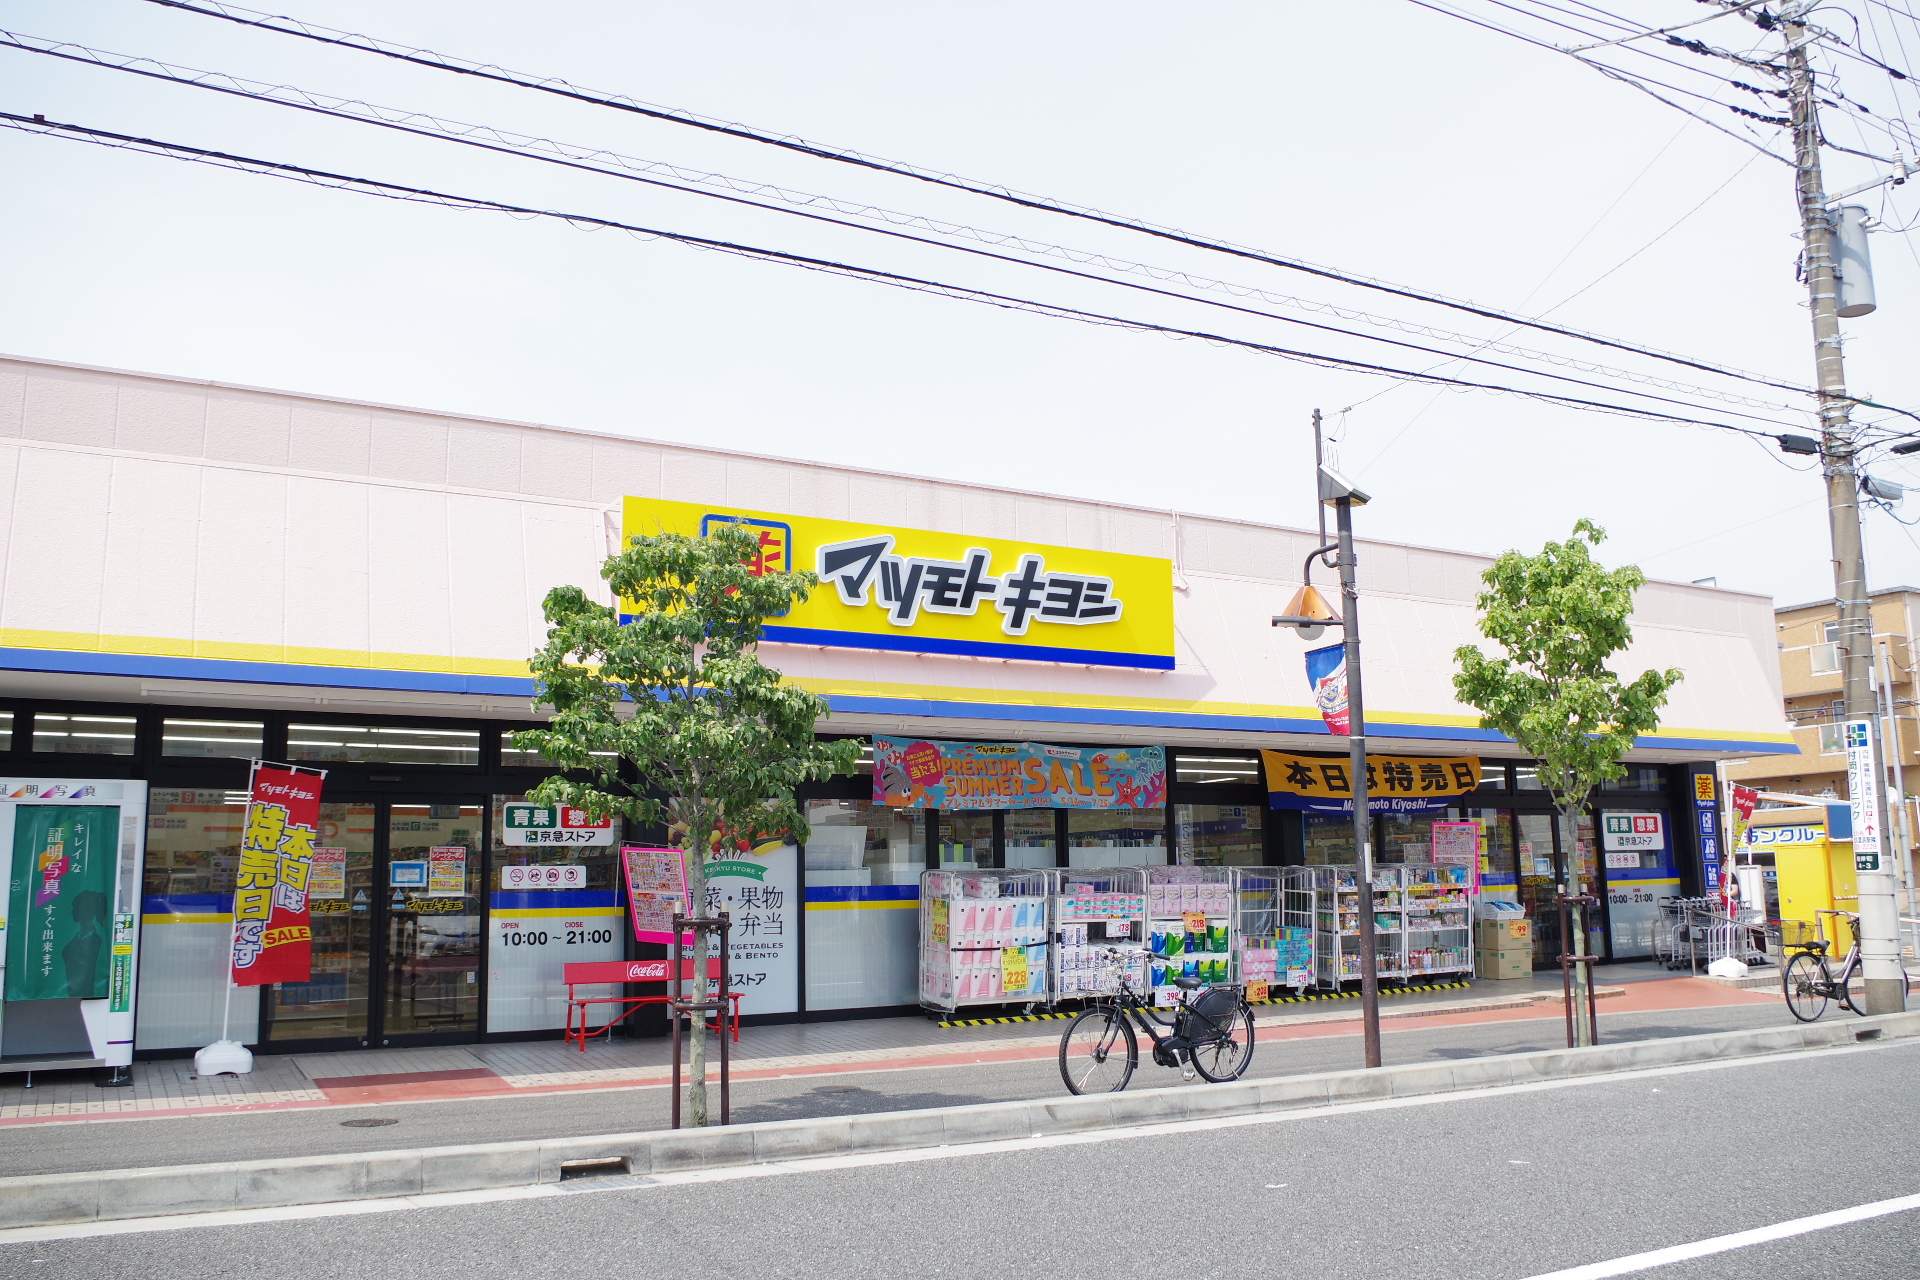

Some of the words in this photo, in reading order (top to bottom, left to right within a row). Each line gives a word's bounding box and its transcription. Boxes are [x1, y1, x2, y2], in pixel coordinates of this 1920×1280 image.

[824, 541, 1118, 629] マツモトキヨシ
[942, 758, 1022, 777] PREMIUM
[943, 775, 1024, 797] SUMMER
[1024, 757, 1114, 797] SALE
[259, 783, 316, 800] マツモトキヨシ
[1343, 800, 1389, 811] Mamoto
[1392, 799, 1427, 811] Kiyoshi
[513, 809, 550, 826] 青果
[539, 831, 596, 843] 京急ストア
[71, 823, 85, 873] キレイな
[43, 827, 65, 895] 証明写真
[41, 904, 56, 977] すぐ出来ます
[264, 927, 310, 945] SALE
[502, 931, 548, 946] 10:00
[566, 930, 612, 944] 21:00
[629, 964, 666, 978] Coca-Cola
